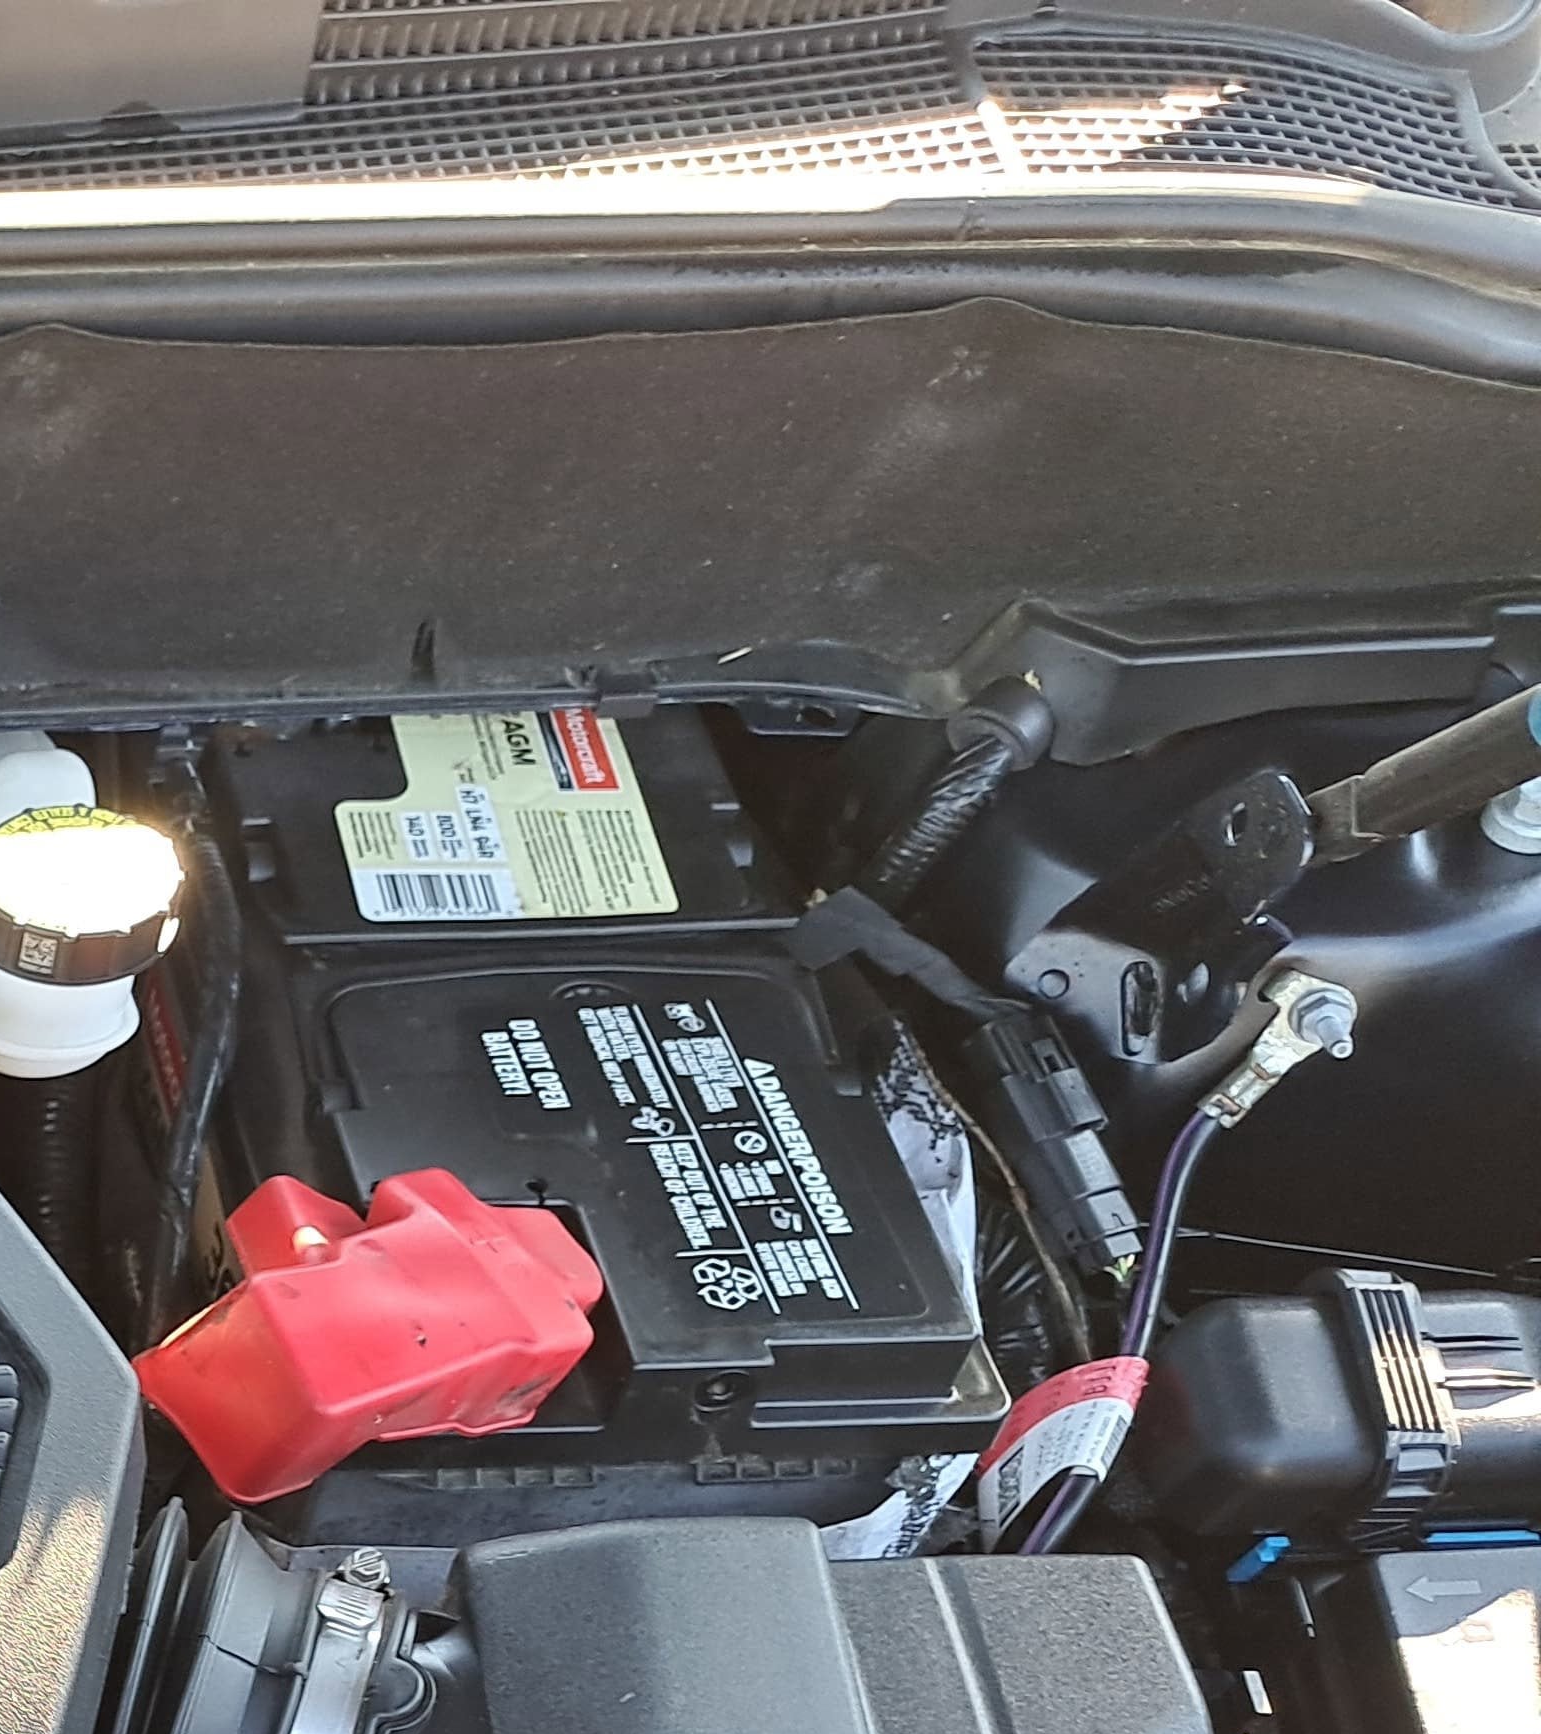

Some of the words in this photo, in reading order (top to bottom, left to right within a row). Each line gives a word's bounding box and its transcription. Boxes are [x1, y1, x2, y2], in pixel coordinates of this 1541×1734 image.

[501, 719, 536, 765] AGM
[564, 706, 605, 784] Motorcraft
[508, 1019, 542, 1040] DO
[481, 1031, 533, 1095] BATTERY!
[517, 1041, 555, 1069] NOT
[530, 1071, 572, 1109] OPEN
[648, 1143, 681, 1178] REACH
[671, 1142, 699, 1168] KEEP
[664, 1179, 688, 1194] OF
[682, 1170, 710, 1191] OUT
[692, 1193, 717, 1206] OF
[700, 1208, 727, 1228] THE
